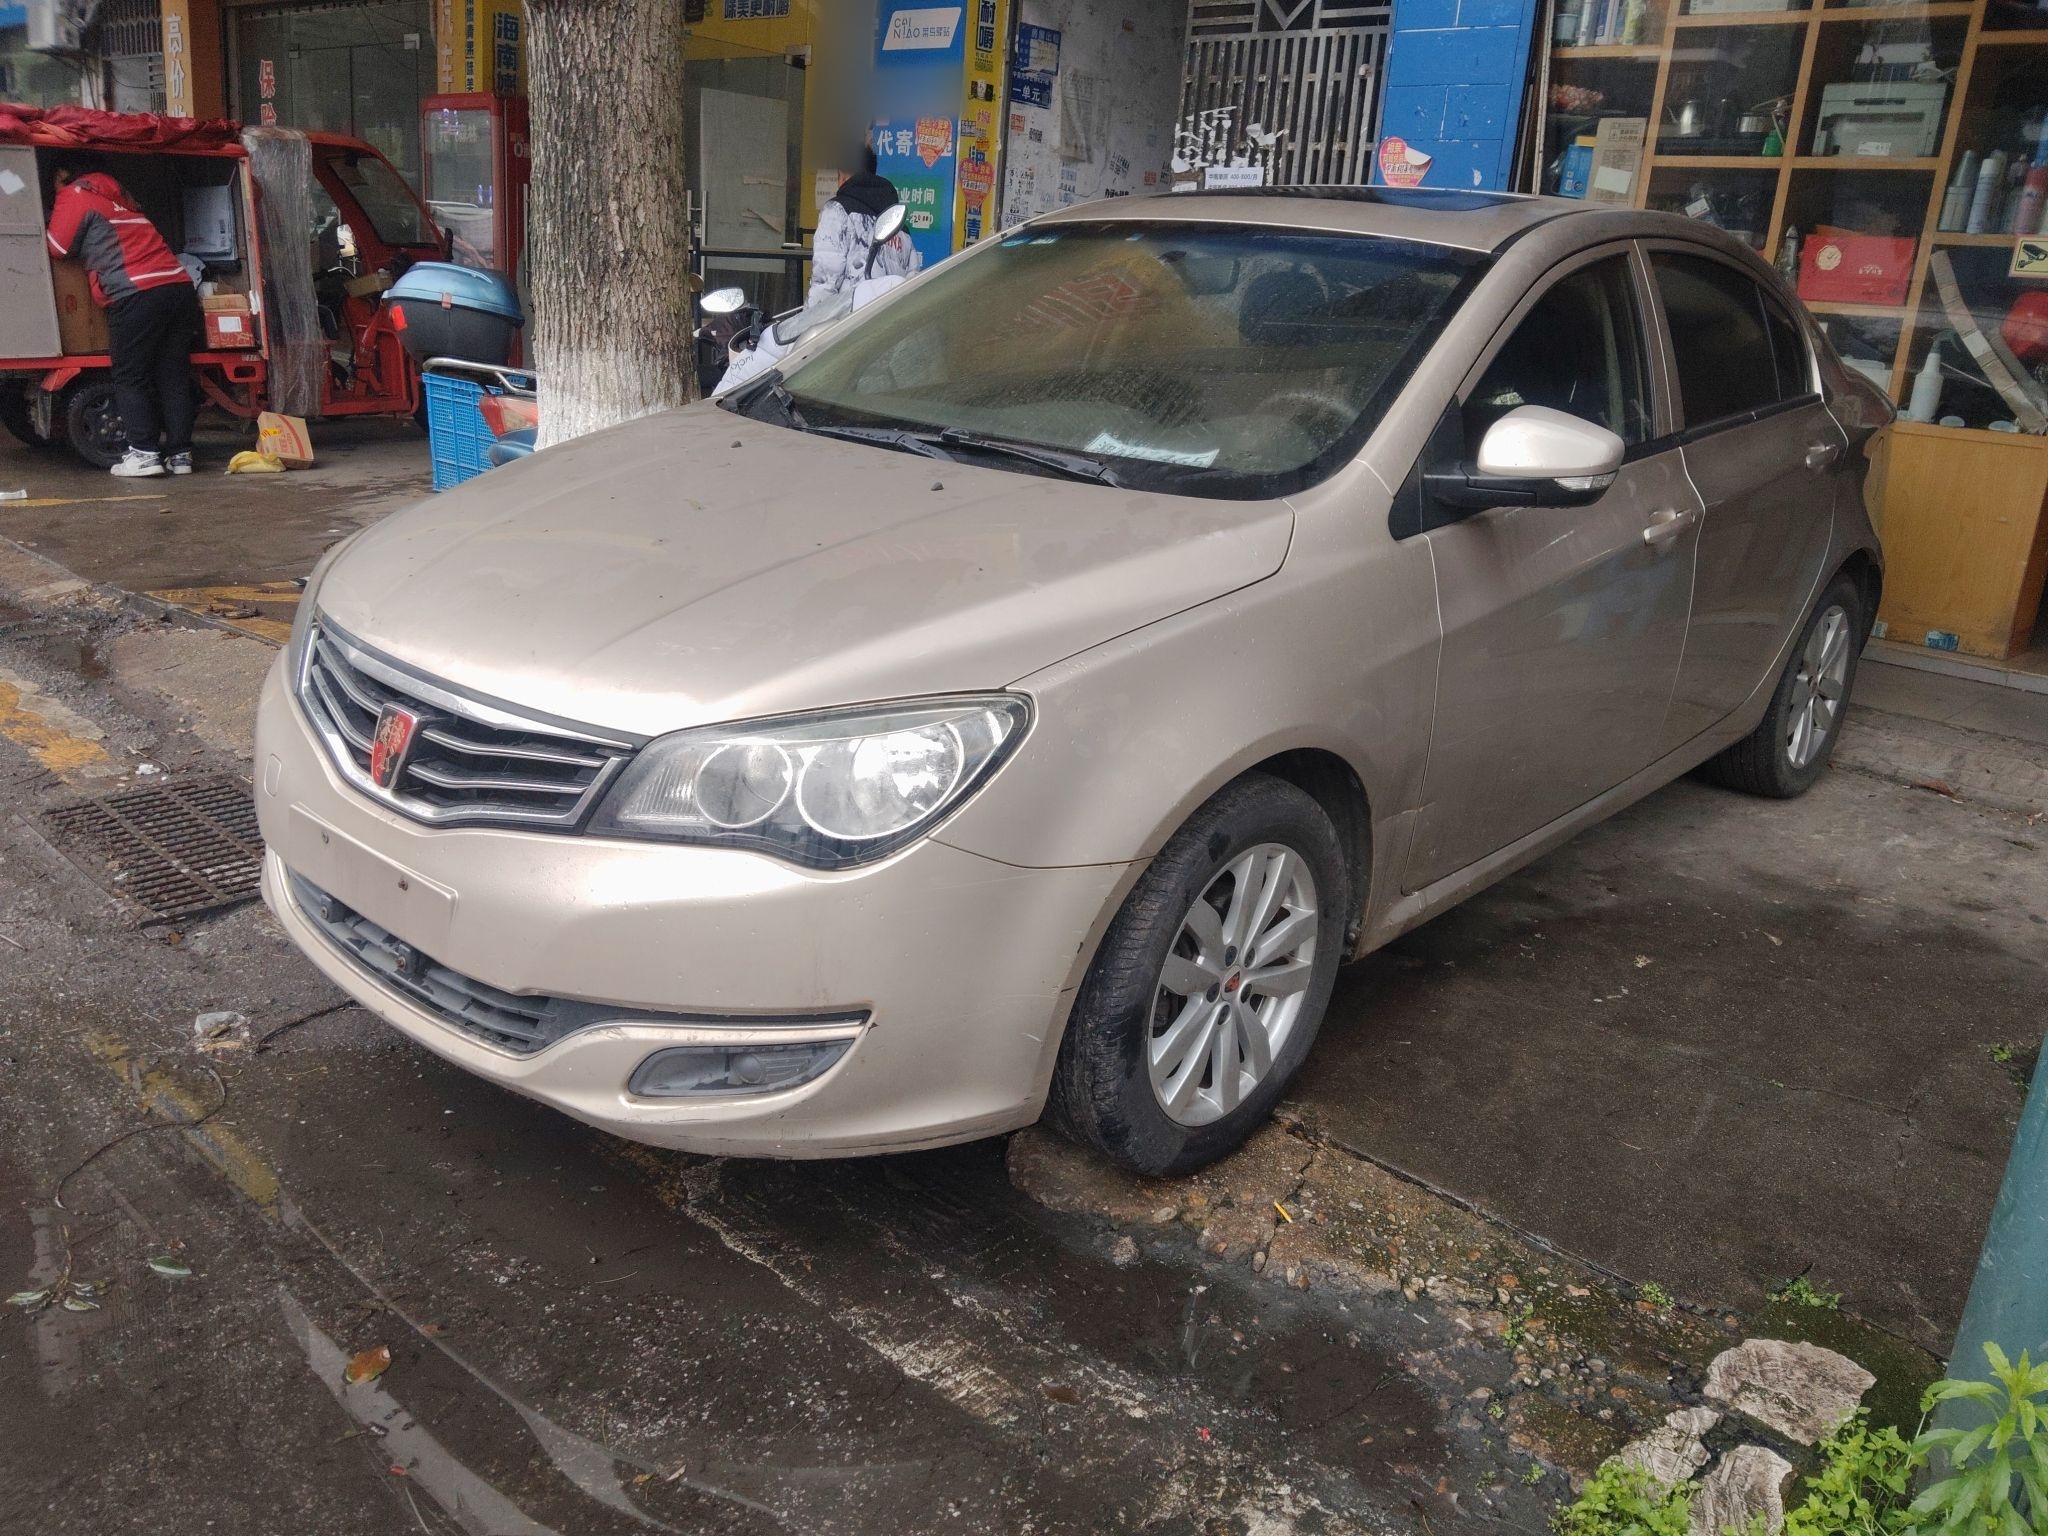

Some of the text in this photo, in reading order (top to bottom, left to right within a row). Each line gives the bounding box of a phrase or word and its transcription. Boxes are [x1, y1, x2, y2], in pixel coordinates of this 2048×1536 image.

[1012, 85, 1041, 101] 一单元
[894, 187, 935, 204] 业时间
